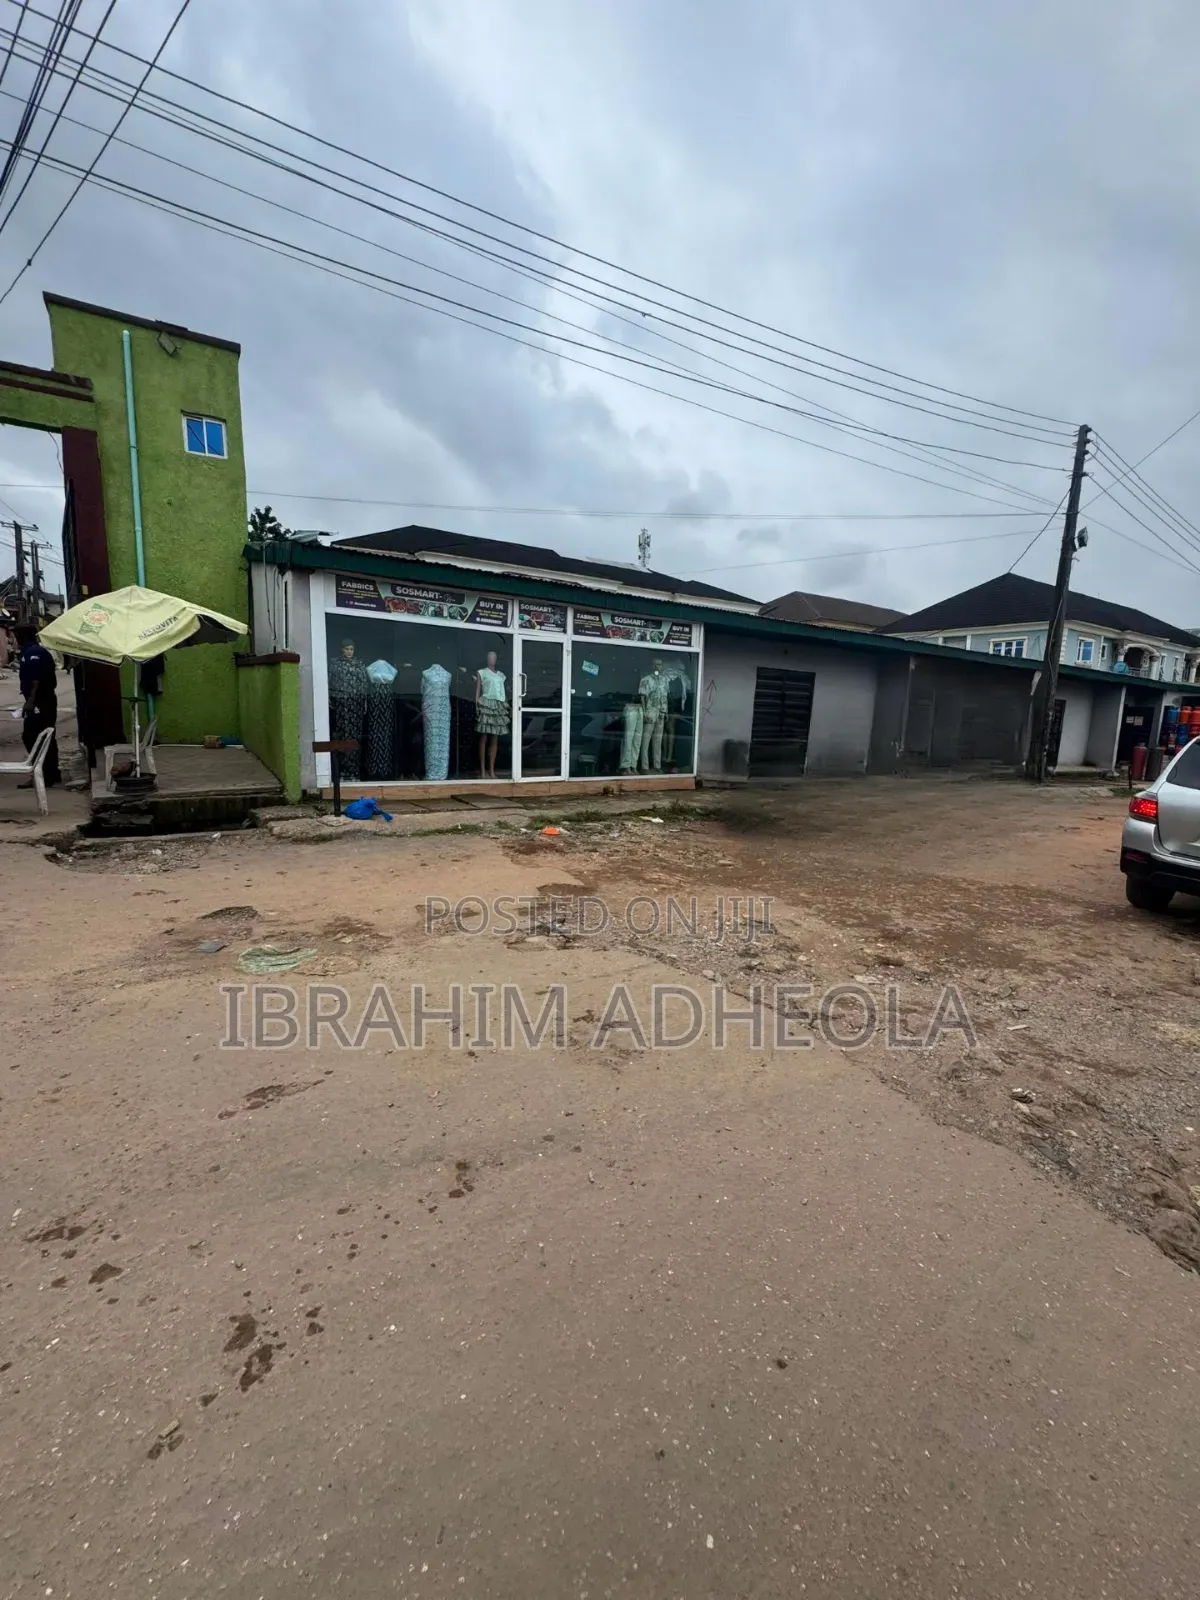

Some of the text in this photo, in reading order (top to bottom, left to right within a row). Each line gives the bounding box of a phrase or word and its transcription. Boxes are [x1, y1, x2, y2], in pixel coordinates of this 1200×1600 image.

[341, 580, 375, 591] FABRICS
[479, 601, 495, 609] BUY
[576, 613, 600, 621] FABRICS
